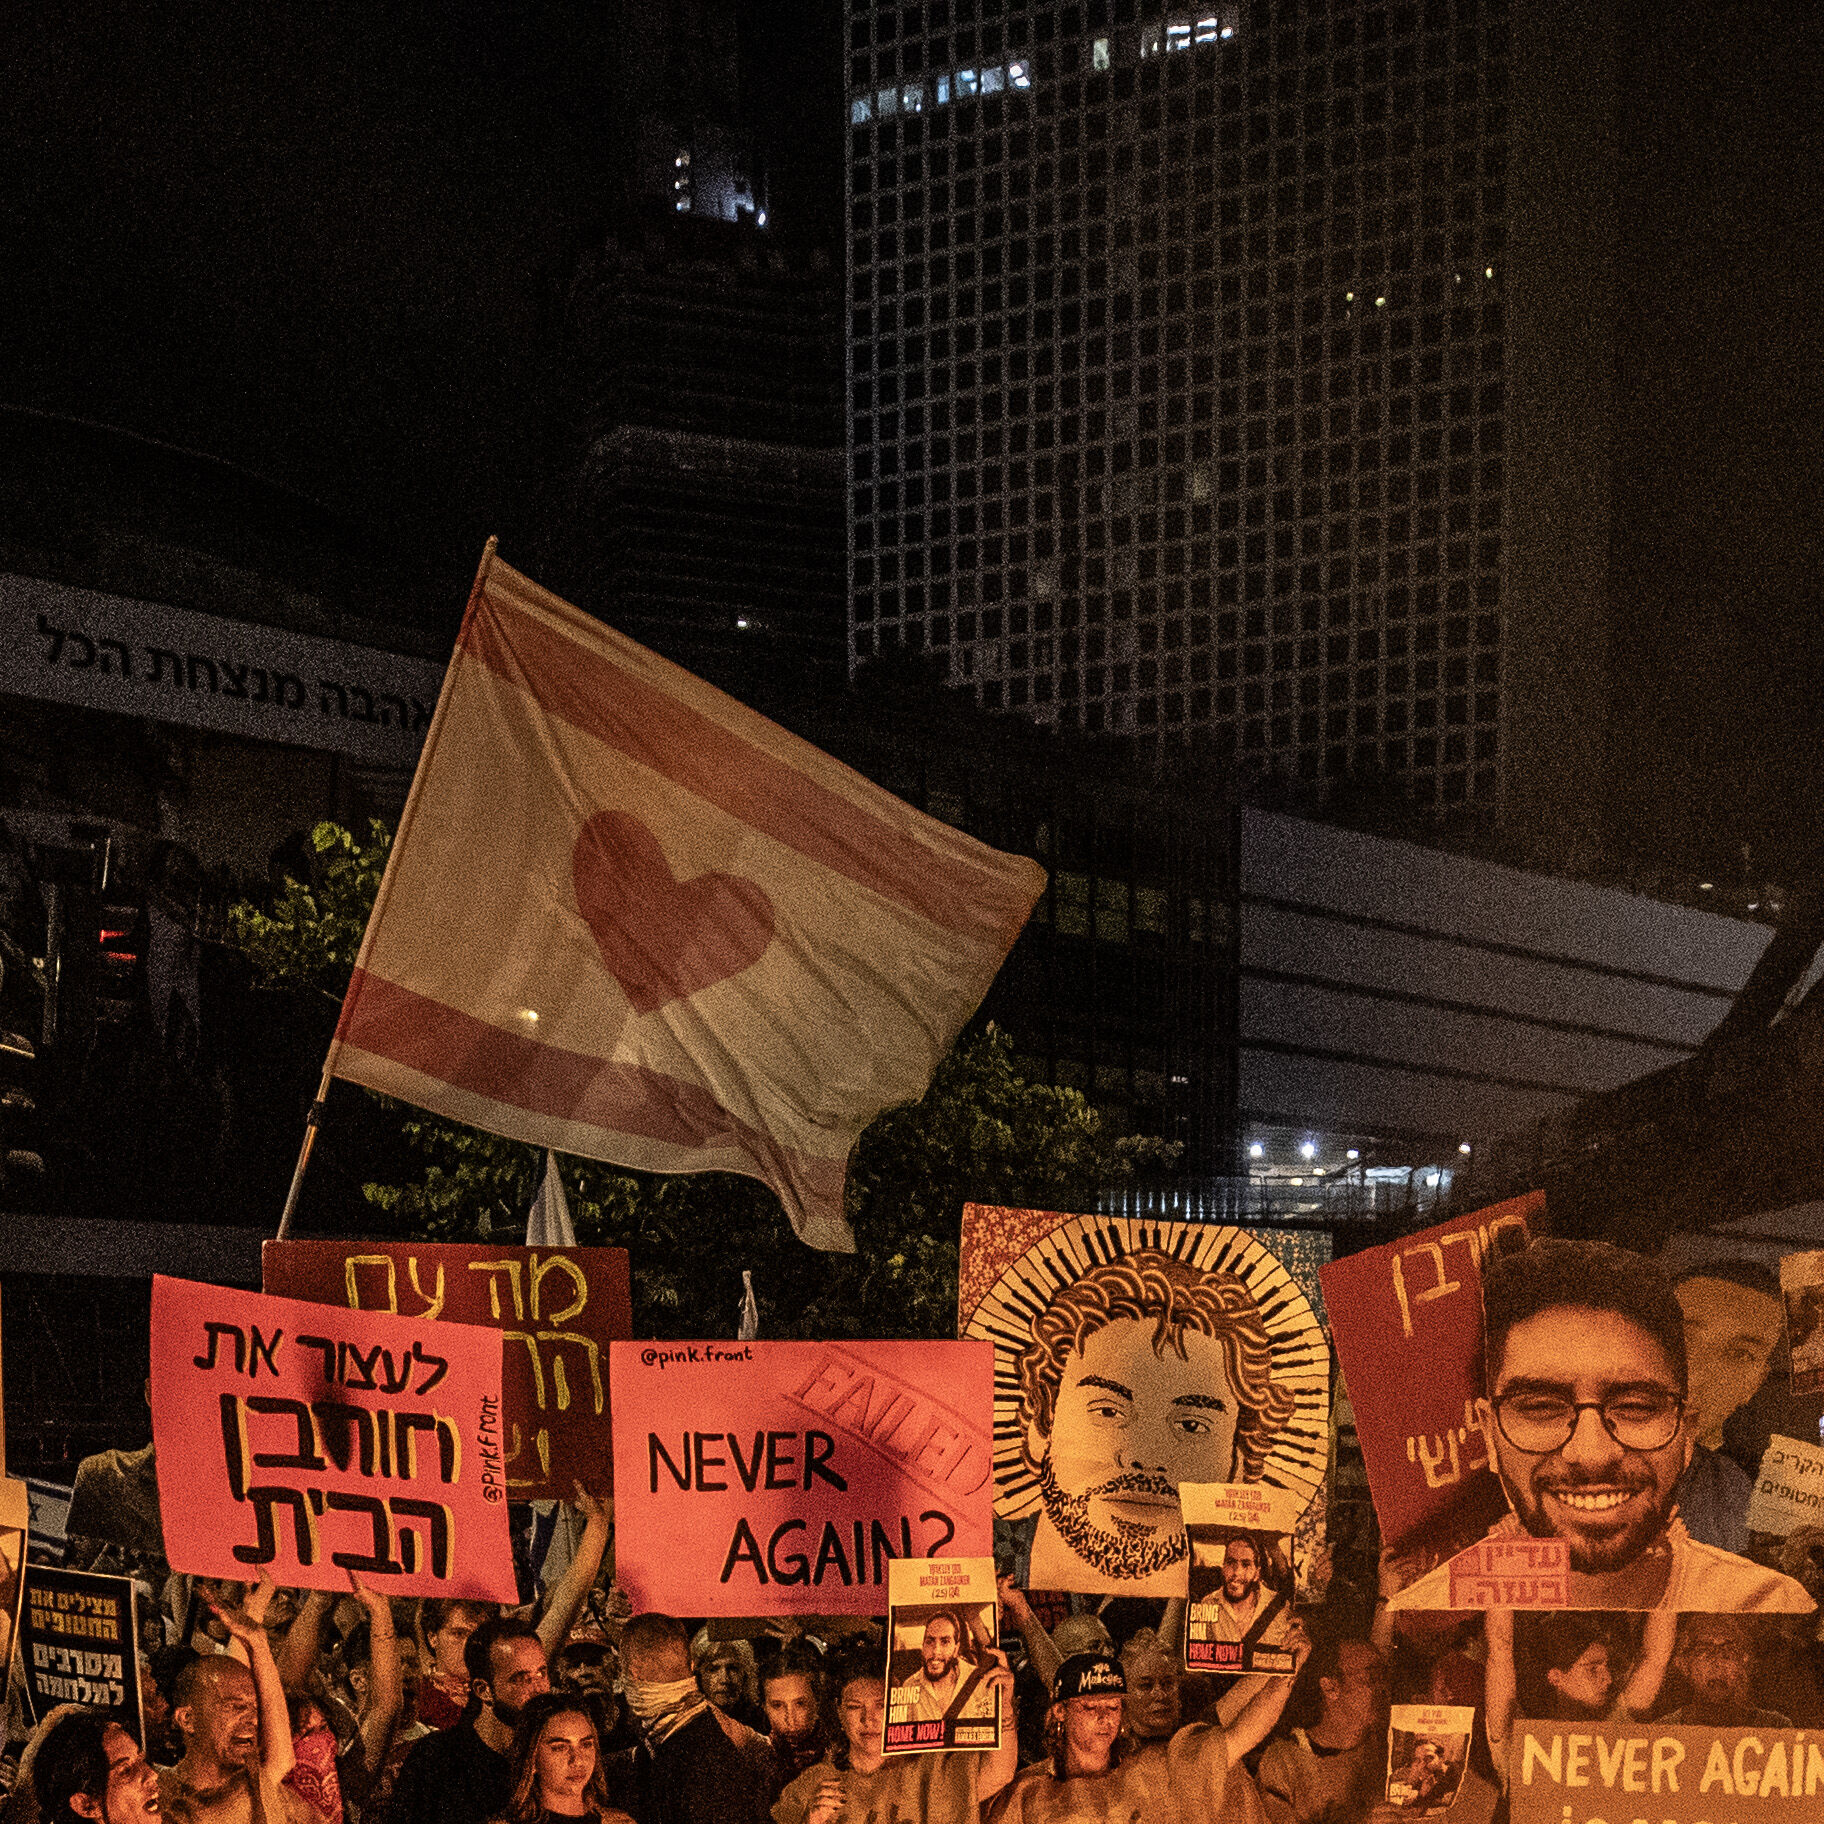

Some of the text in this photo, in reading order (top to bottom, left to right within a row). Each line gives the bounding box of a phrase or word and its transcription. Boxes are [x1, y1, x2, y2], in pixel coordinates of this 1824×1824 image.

[37, 615, 434, 732] אהבה מנצחת הכל
[344, 1252, 588, 1326] מה עם
[193, 1320, 283, 1377] את
[296, 1334, 449, 1396] לעצור
[640, 1344, 755, 1369] @pink.front
[220, 1391, 463, 1502] חורבן
[789, 1358, 992, 1496] FAILED
[647, 1429, 848, 1493] NEVER
[231, 1487, 457, 1582] הבית
[720, 1509, 956, 1586] AGAIN?
[1484, 1543, 1563, 1573] עדיין
[30, 1608, 119, 1640] החטופים
[32, 1643, 123, 1680] מסרבים
[34, 1671, 125, 1707] למלחמה
[888, 1705, 908, 1723] HIM
[890, 1686, 920, 1705] BRING
[1521, 1732, 1687, 1794] NEVER
